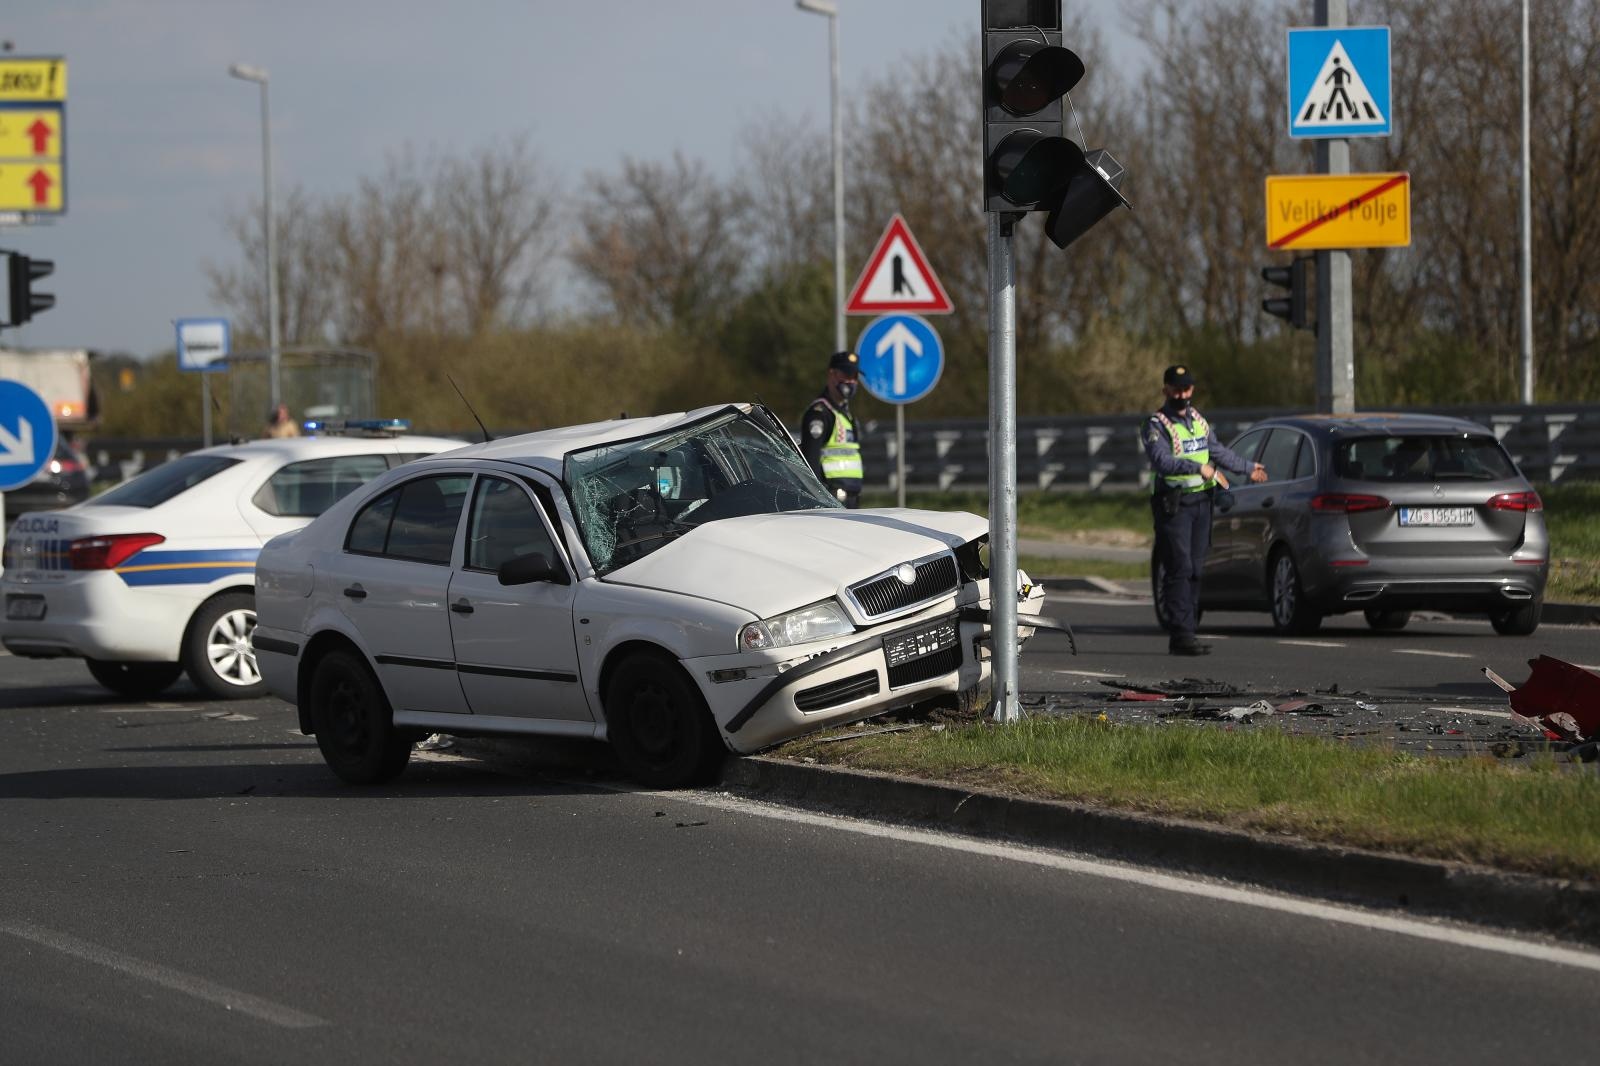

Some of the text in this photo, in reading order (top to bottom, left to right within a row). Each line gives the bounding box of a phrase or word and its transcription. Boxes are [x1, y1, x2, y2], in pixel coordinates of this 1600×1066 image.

[1280, 198, 1398, 227] Veliko Polje
[1408, 507, 1423, 523] ZG
